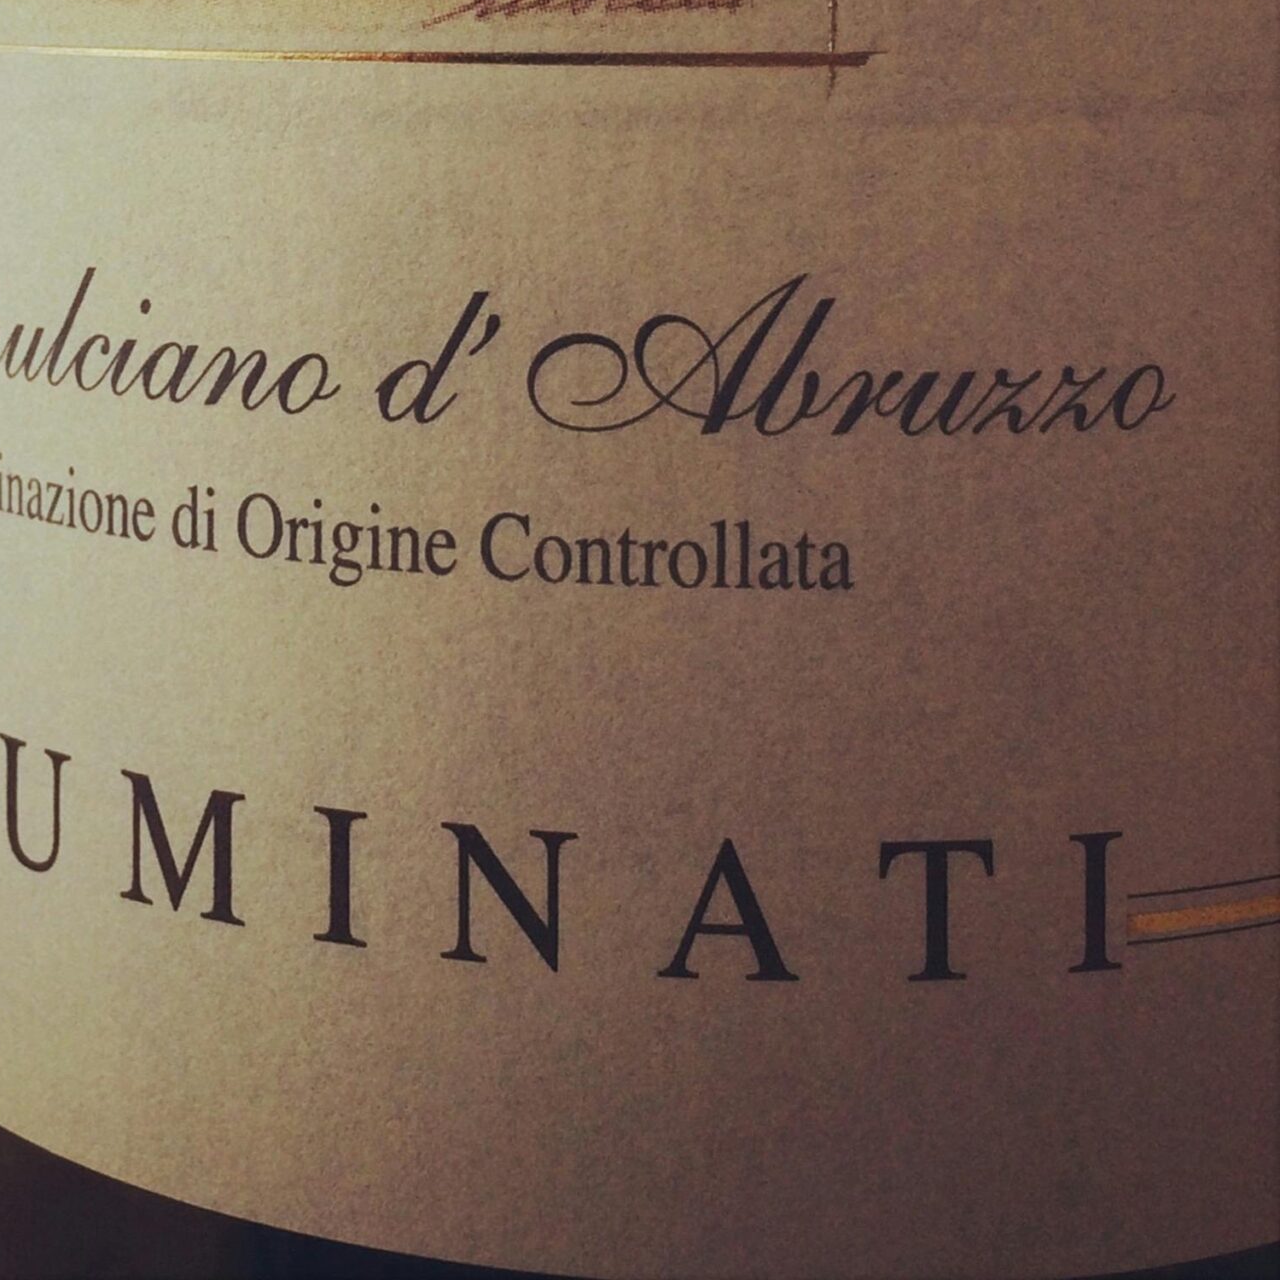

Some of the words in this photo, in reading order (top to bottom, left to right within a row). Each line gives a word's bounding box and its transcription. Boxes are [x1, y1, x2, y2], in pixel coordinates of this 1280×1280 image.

[526, 272, 1177, 436] Abruzzo
[171, 485, 219, 552] di
[236, 491, 458, 588] Origine
[479, 510, 855, 591] Controllata
